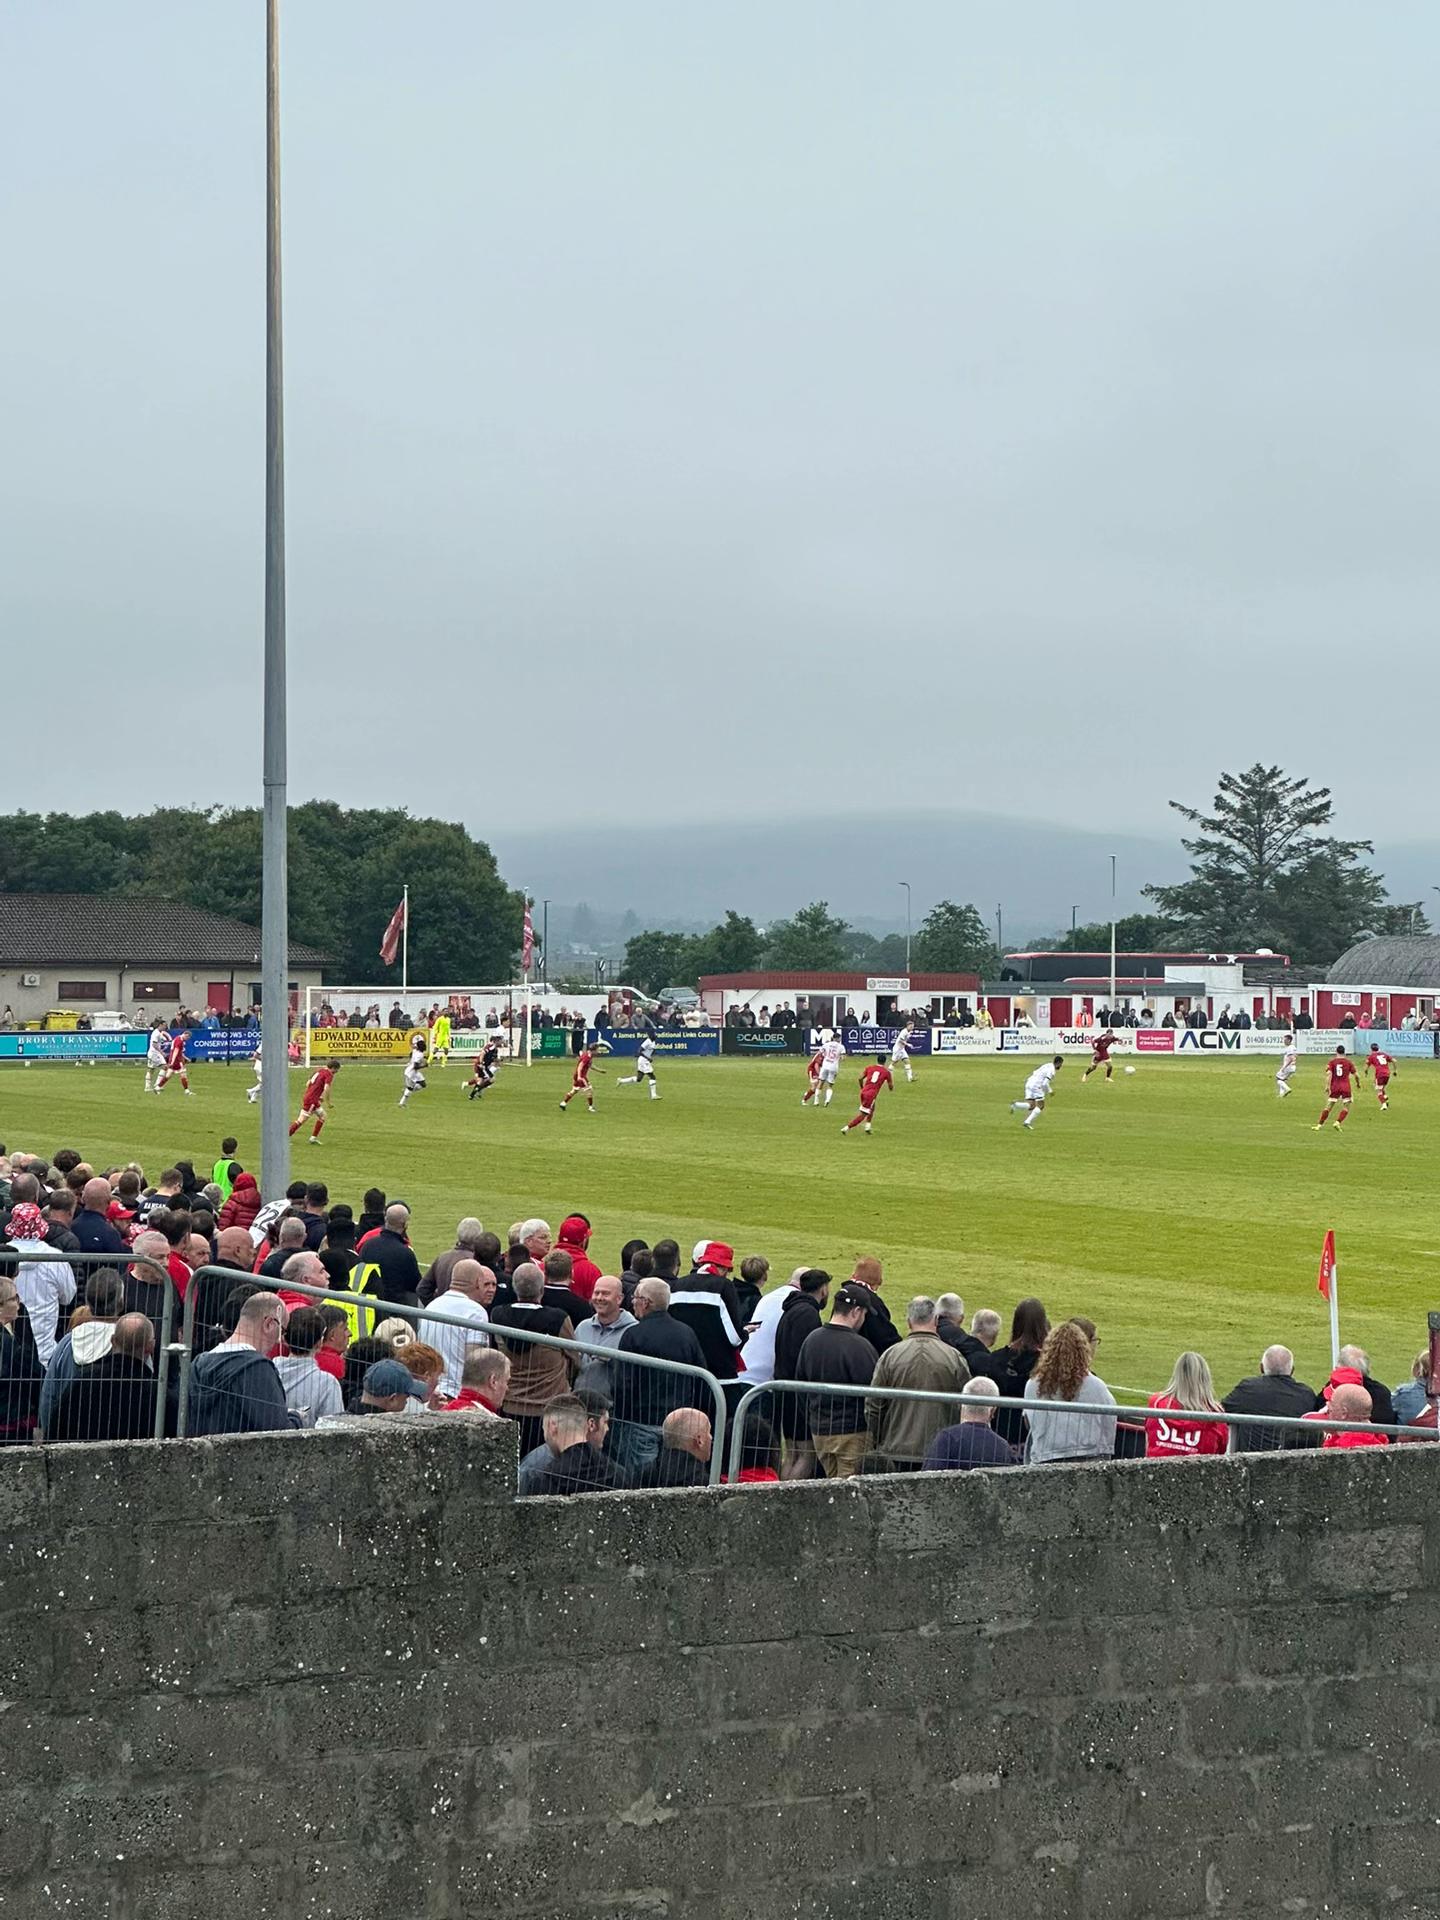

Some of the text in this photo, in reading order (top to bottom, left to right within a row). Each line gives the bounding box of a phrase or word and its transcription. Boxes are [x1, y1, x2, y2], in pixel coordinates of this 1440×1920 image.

[62, 1035, 127, 1043] TRANSPORT
[314, 1032, 407, 1041] EDWARD MACKAY
[1179, 1031, 1241, 1049] ACM
[1386, 1032, 1434, 1044] JAMES ROSS
